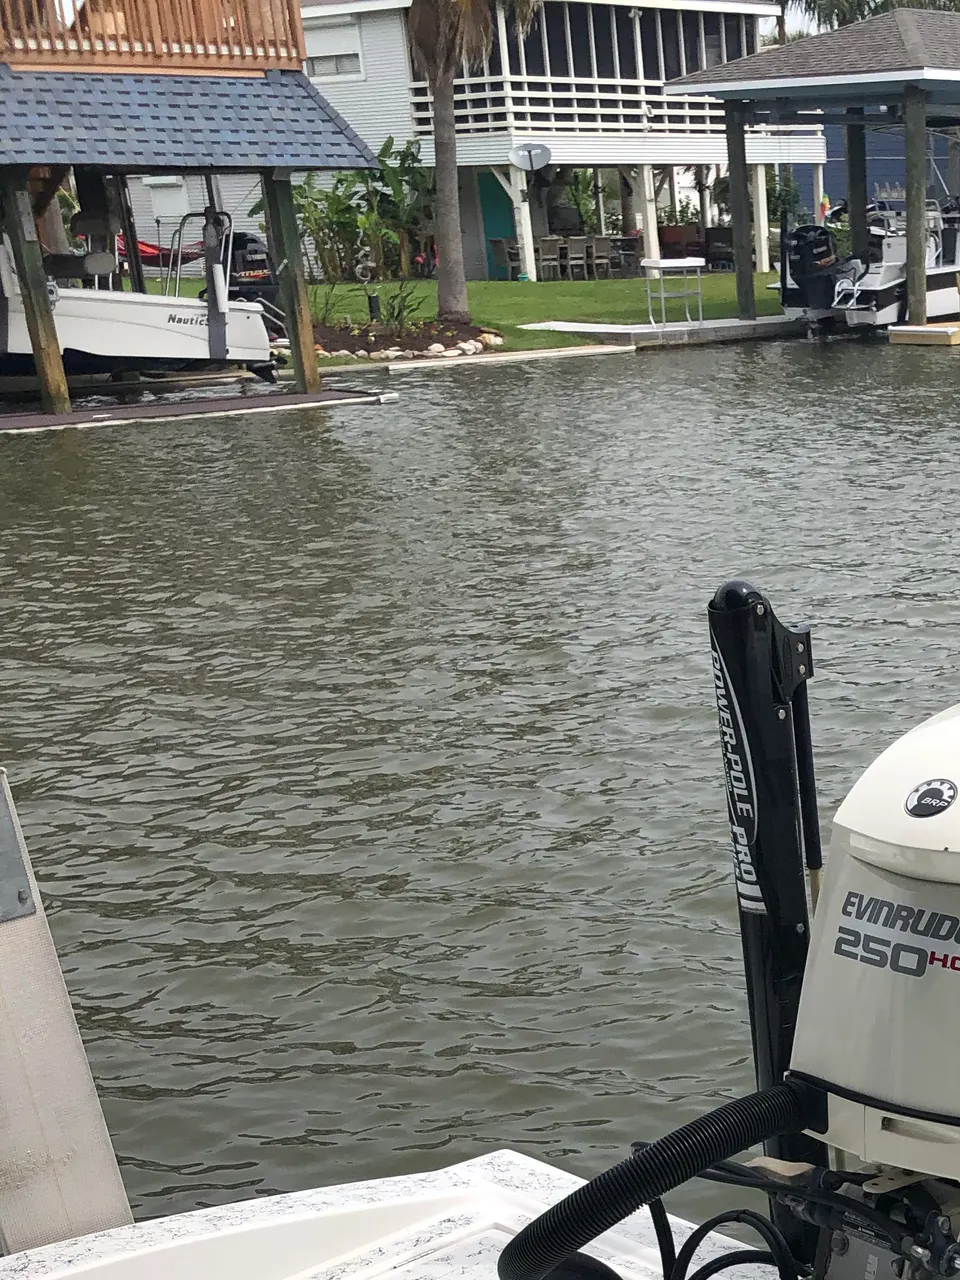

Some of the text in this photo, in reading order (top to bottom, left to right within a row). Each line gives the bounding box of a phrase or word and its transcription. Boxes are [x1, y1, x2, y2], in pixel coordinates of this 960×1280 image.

[711, 648, 754, 818] POWER-POLE
[920, 797, 949, 807] BRP
[732, 825, 758, 882] PRO
[833, 925, 929, 978] 250
